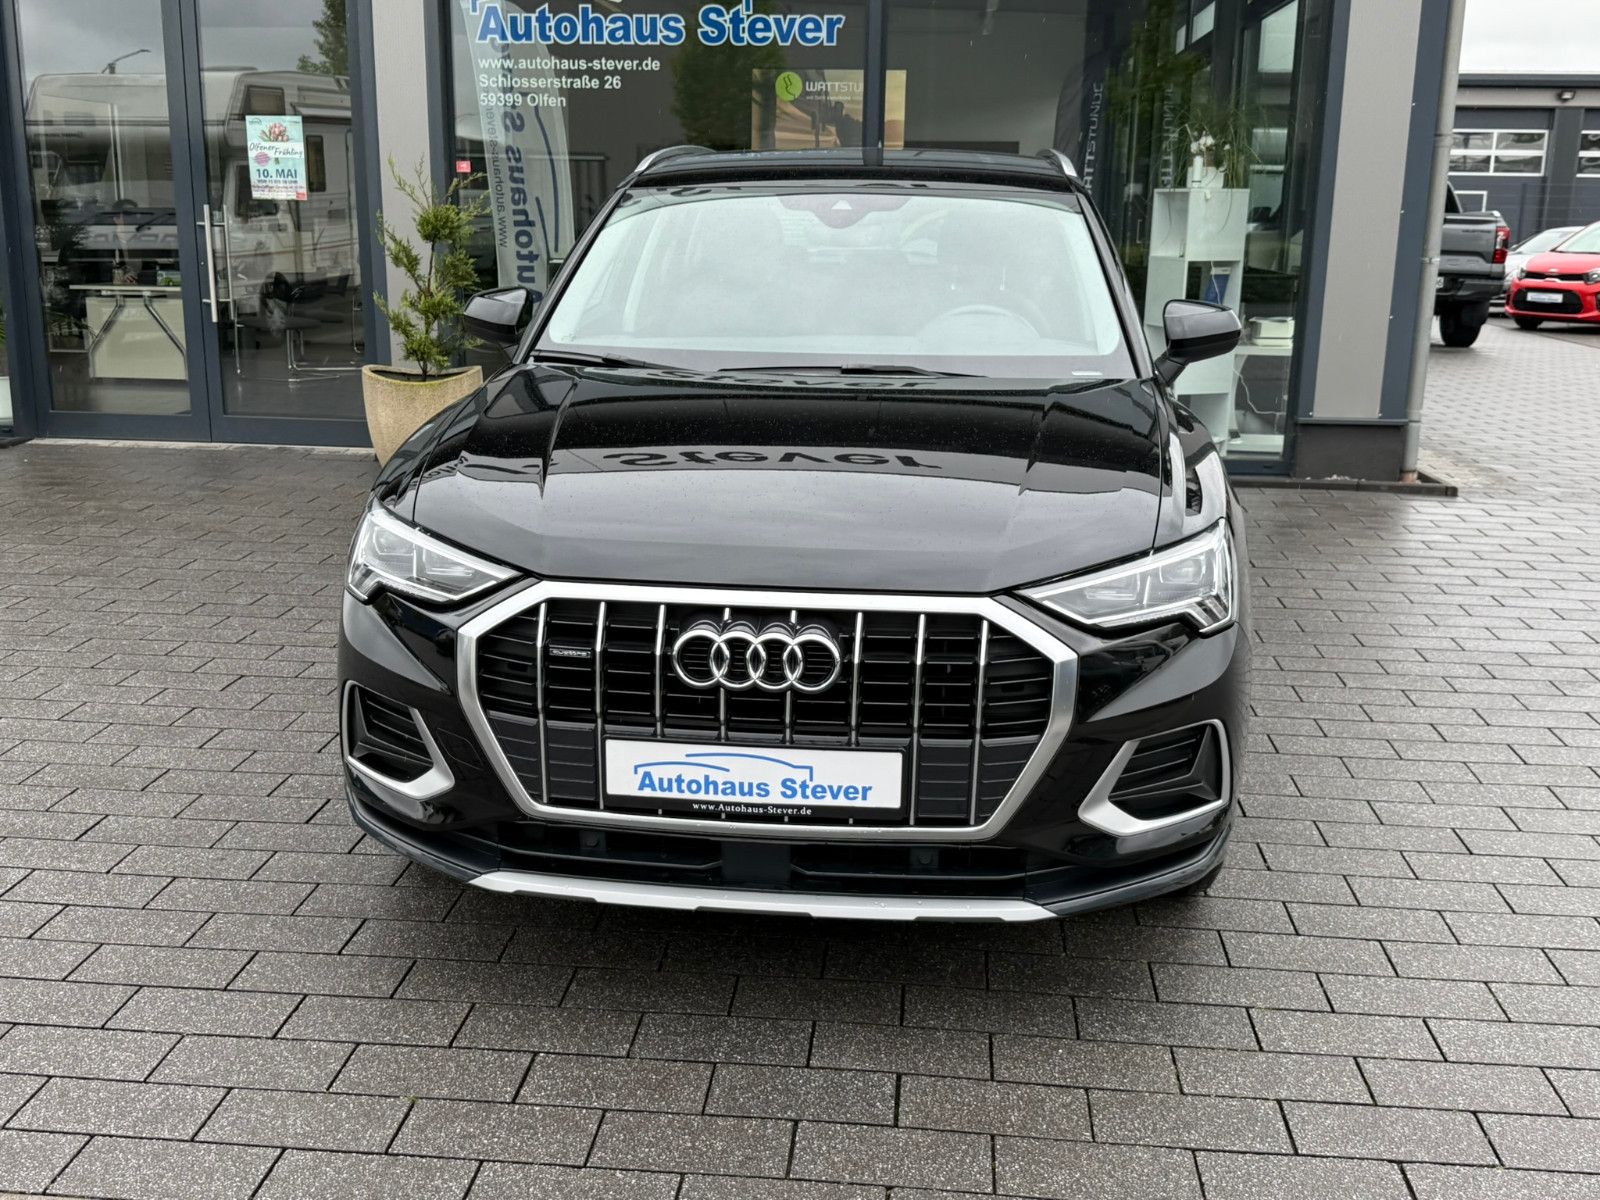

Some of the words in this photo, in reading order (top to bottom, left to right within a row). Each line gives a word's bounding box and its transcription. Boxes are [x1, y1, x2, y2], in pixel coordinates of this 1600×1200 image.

[476, 3, 685, 45] Autohaus
[698, 4, 845, 46] Stever
[478, 56, 660, 71] www.autohaus-stever.de
[479, 75, 600, 89] Schlosserstraße
[604, 75, 621, 89] 26
[805, 81, 863, 92] WATTSTU
[479, 93, 522, 107] 59399
[527, 94, 566, 107] Olfen
[256, 168, 273, 179] 10.
[275, 168, 298, 179] MAI
[637, 771, 770, 798] Autohaus
[780, 777, 873, 801] Stever
[692, 802, 812, 816] www.Autohaus-Stever.de
